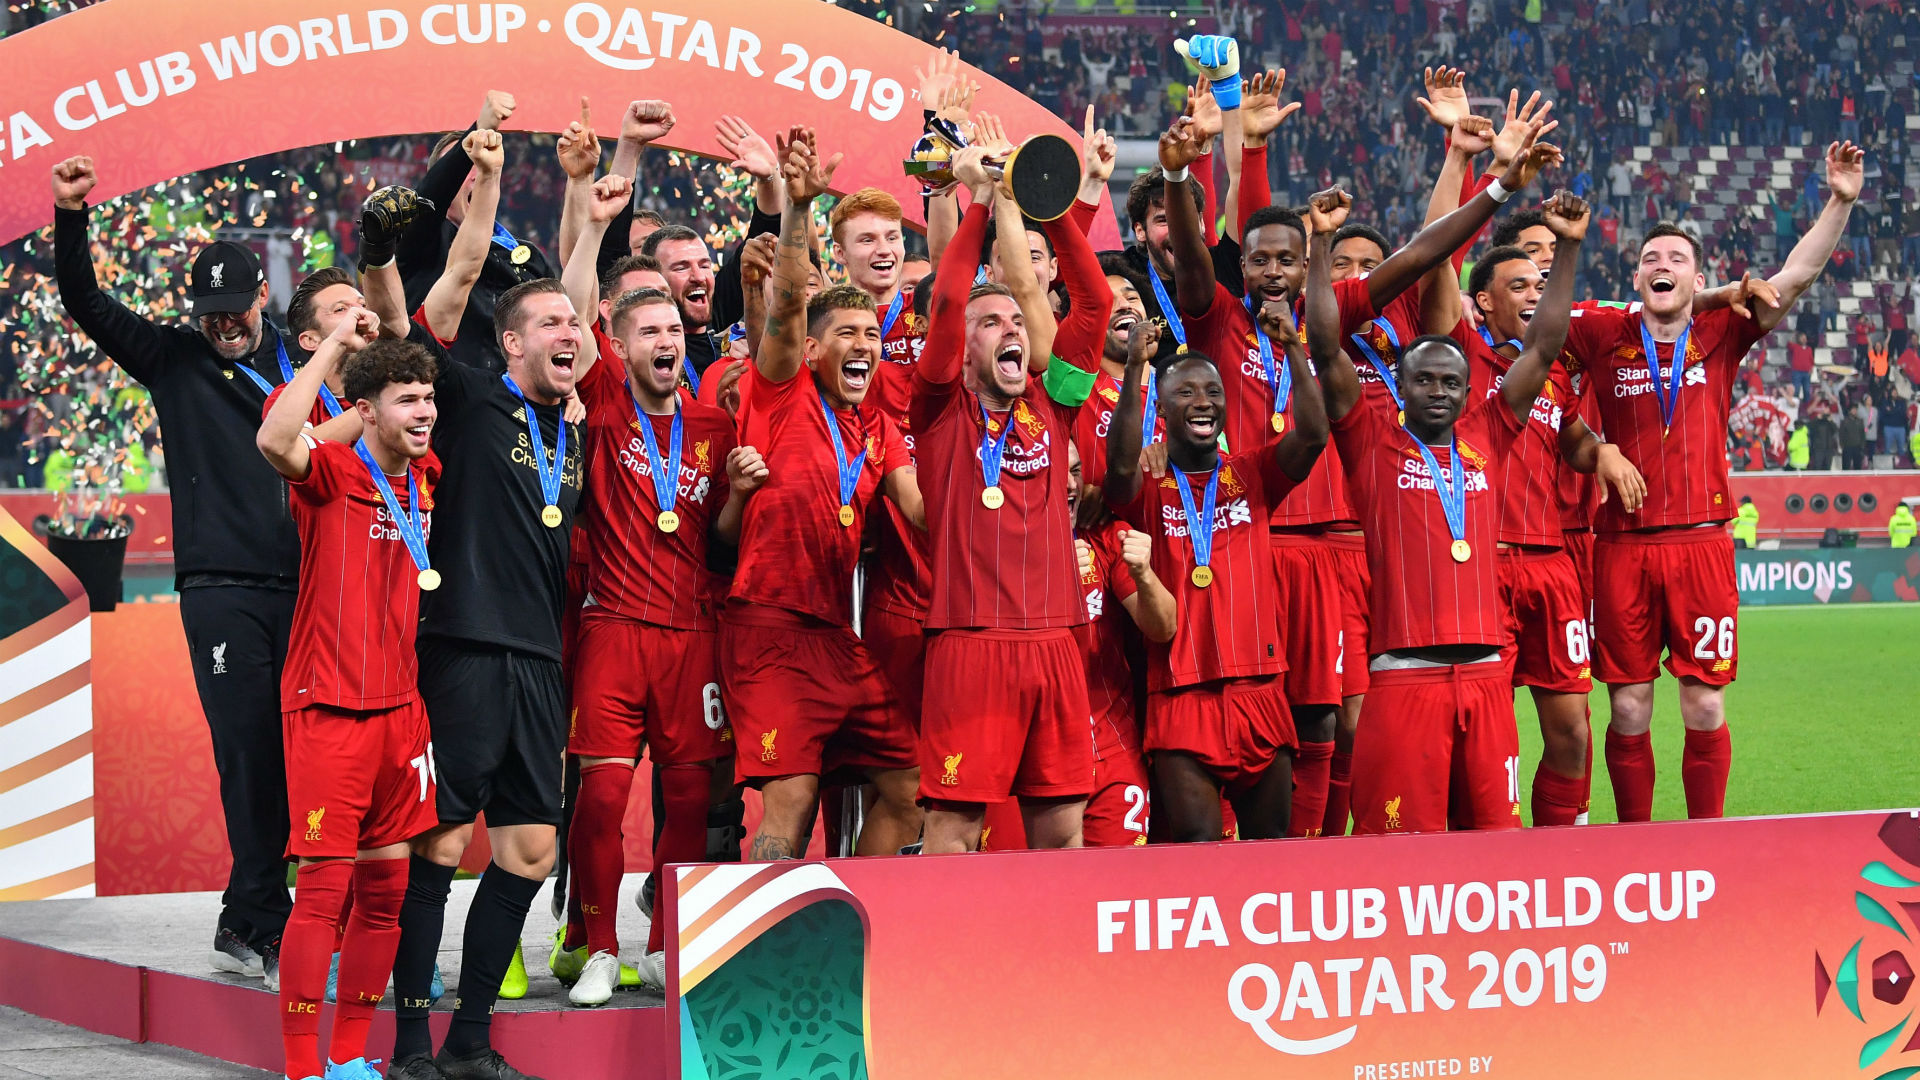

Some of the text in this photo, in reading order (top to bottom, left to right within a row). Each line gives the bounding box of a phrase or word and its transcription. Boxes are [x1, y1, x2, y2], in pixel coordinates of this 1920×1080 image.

[54, 51, 197, 131] CLUB
[200, 9, 409, 81] WORLD
[421, 4, 526, 45] CUP
[564, 3, 764, 78] QATAR
[774, 43, 905, 122] 2019
[1736, 561, 1853, 592] MPIONS
[1694, 616, 1734, 660] 26
[1124, 784, 1150, 835] 2
[1097, 870, 1716, 953] FIFA CLUB WORLD CUP
[1227, 942, 1629, 1056] QATAR 2019 TM
[1354, 1056, 1493, 1080] PRESENTED BY
